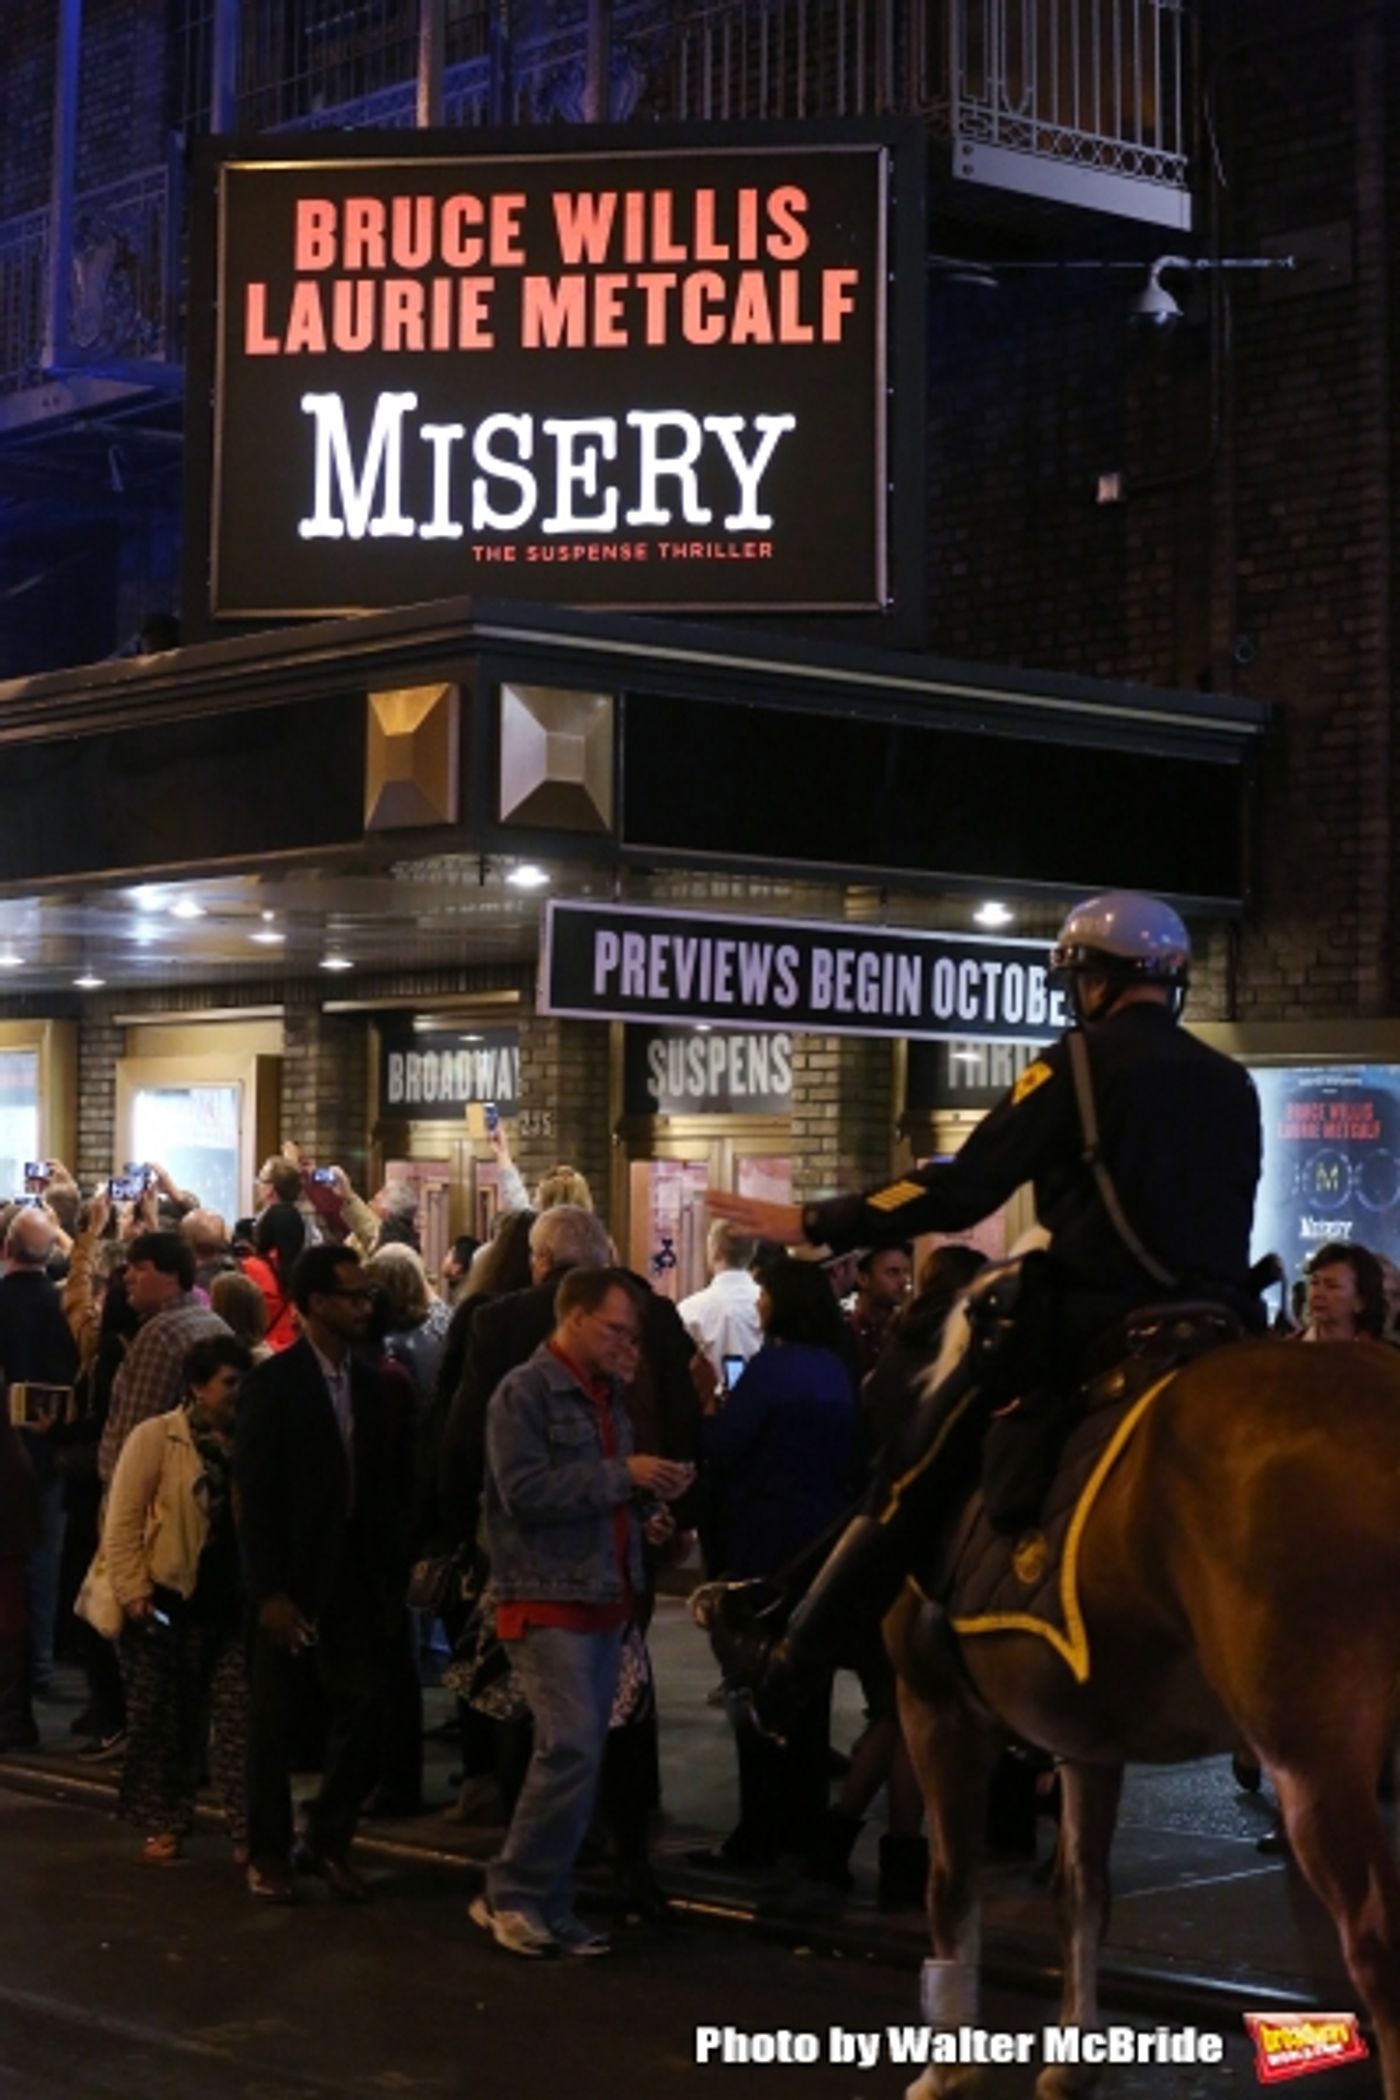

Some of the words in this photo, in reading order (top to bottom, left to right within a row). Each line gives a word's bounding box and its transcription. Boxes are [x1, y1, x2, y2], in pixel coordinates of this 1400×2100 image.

[294, 194, 527, 271] BRUCE
[552, 186, 809, 265] WILLIS
[244, 276, 496, 355] LAURIE
[521, 268, 858, 349] METCALF
[298, 391, 796, 540] MISERY
[471, 544, 516, 562] THE
[525, 542, 648, 562] SUSPENSE
[657, 541, 774, 560] THRILLER
[593, 930, 800, 1009] PREVIEWS
[809, 948, 922, 1017] BEGIN
[932, 956, 1077, 1028] OCTOBE
[646, 1033, 793, 1097] SUSPENS
